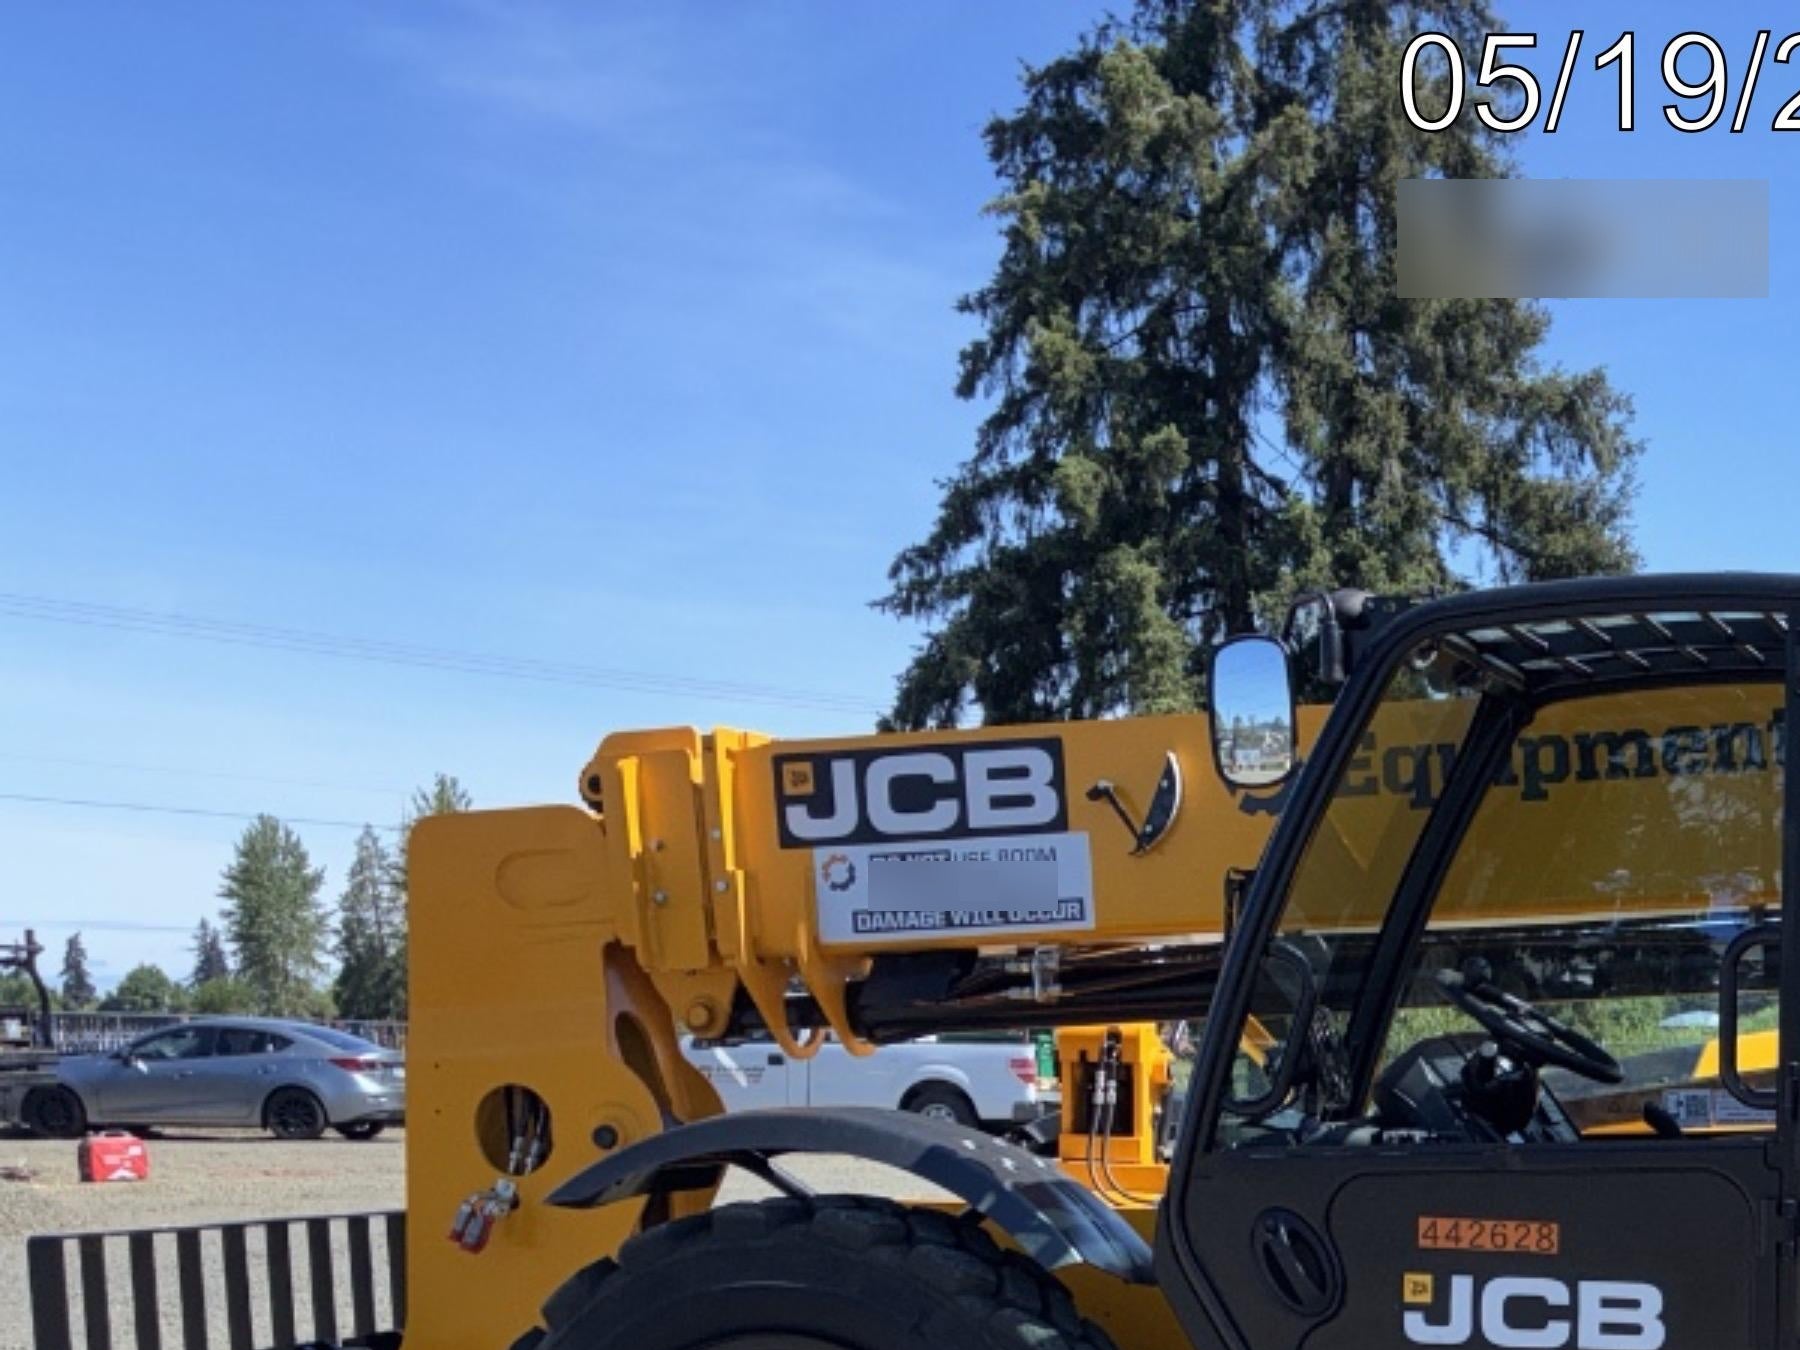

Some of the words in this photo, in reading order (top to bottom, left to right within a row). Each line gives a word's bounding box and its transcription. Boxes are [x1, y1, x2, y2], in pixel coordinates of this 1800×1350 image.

[785, 747, 1060, 840] JCB
[857, 910, 946, 931] DAMAGE
[1421, 1220, 1555, 1250] 442628
